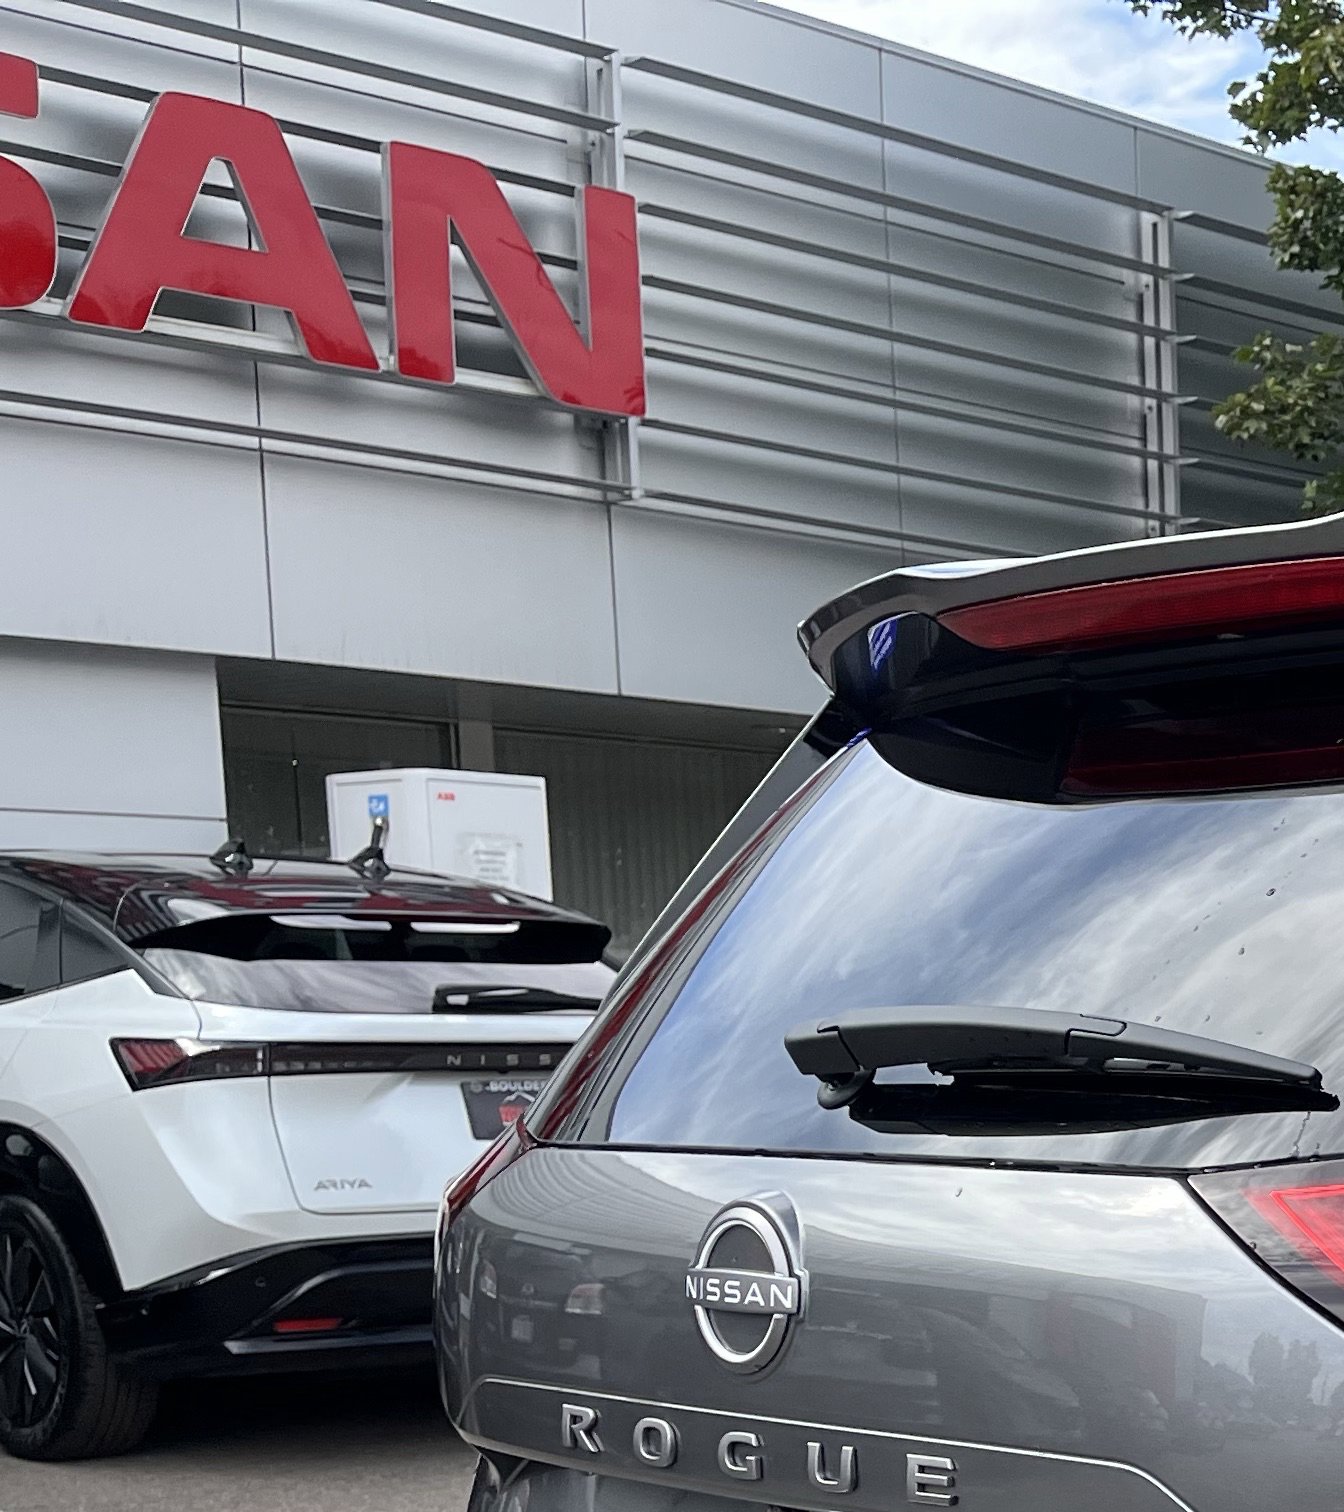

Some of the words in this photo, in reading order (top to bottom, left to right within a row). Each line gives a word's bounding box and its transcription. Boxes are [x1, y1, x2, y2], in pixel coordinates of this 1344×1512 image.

[0, 52, 646, 417] AN
[684, 1273, 793, 1309] NISSAN
[561, 1402, 960, 1507] ROGUE
